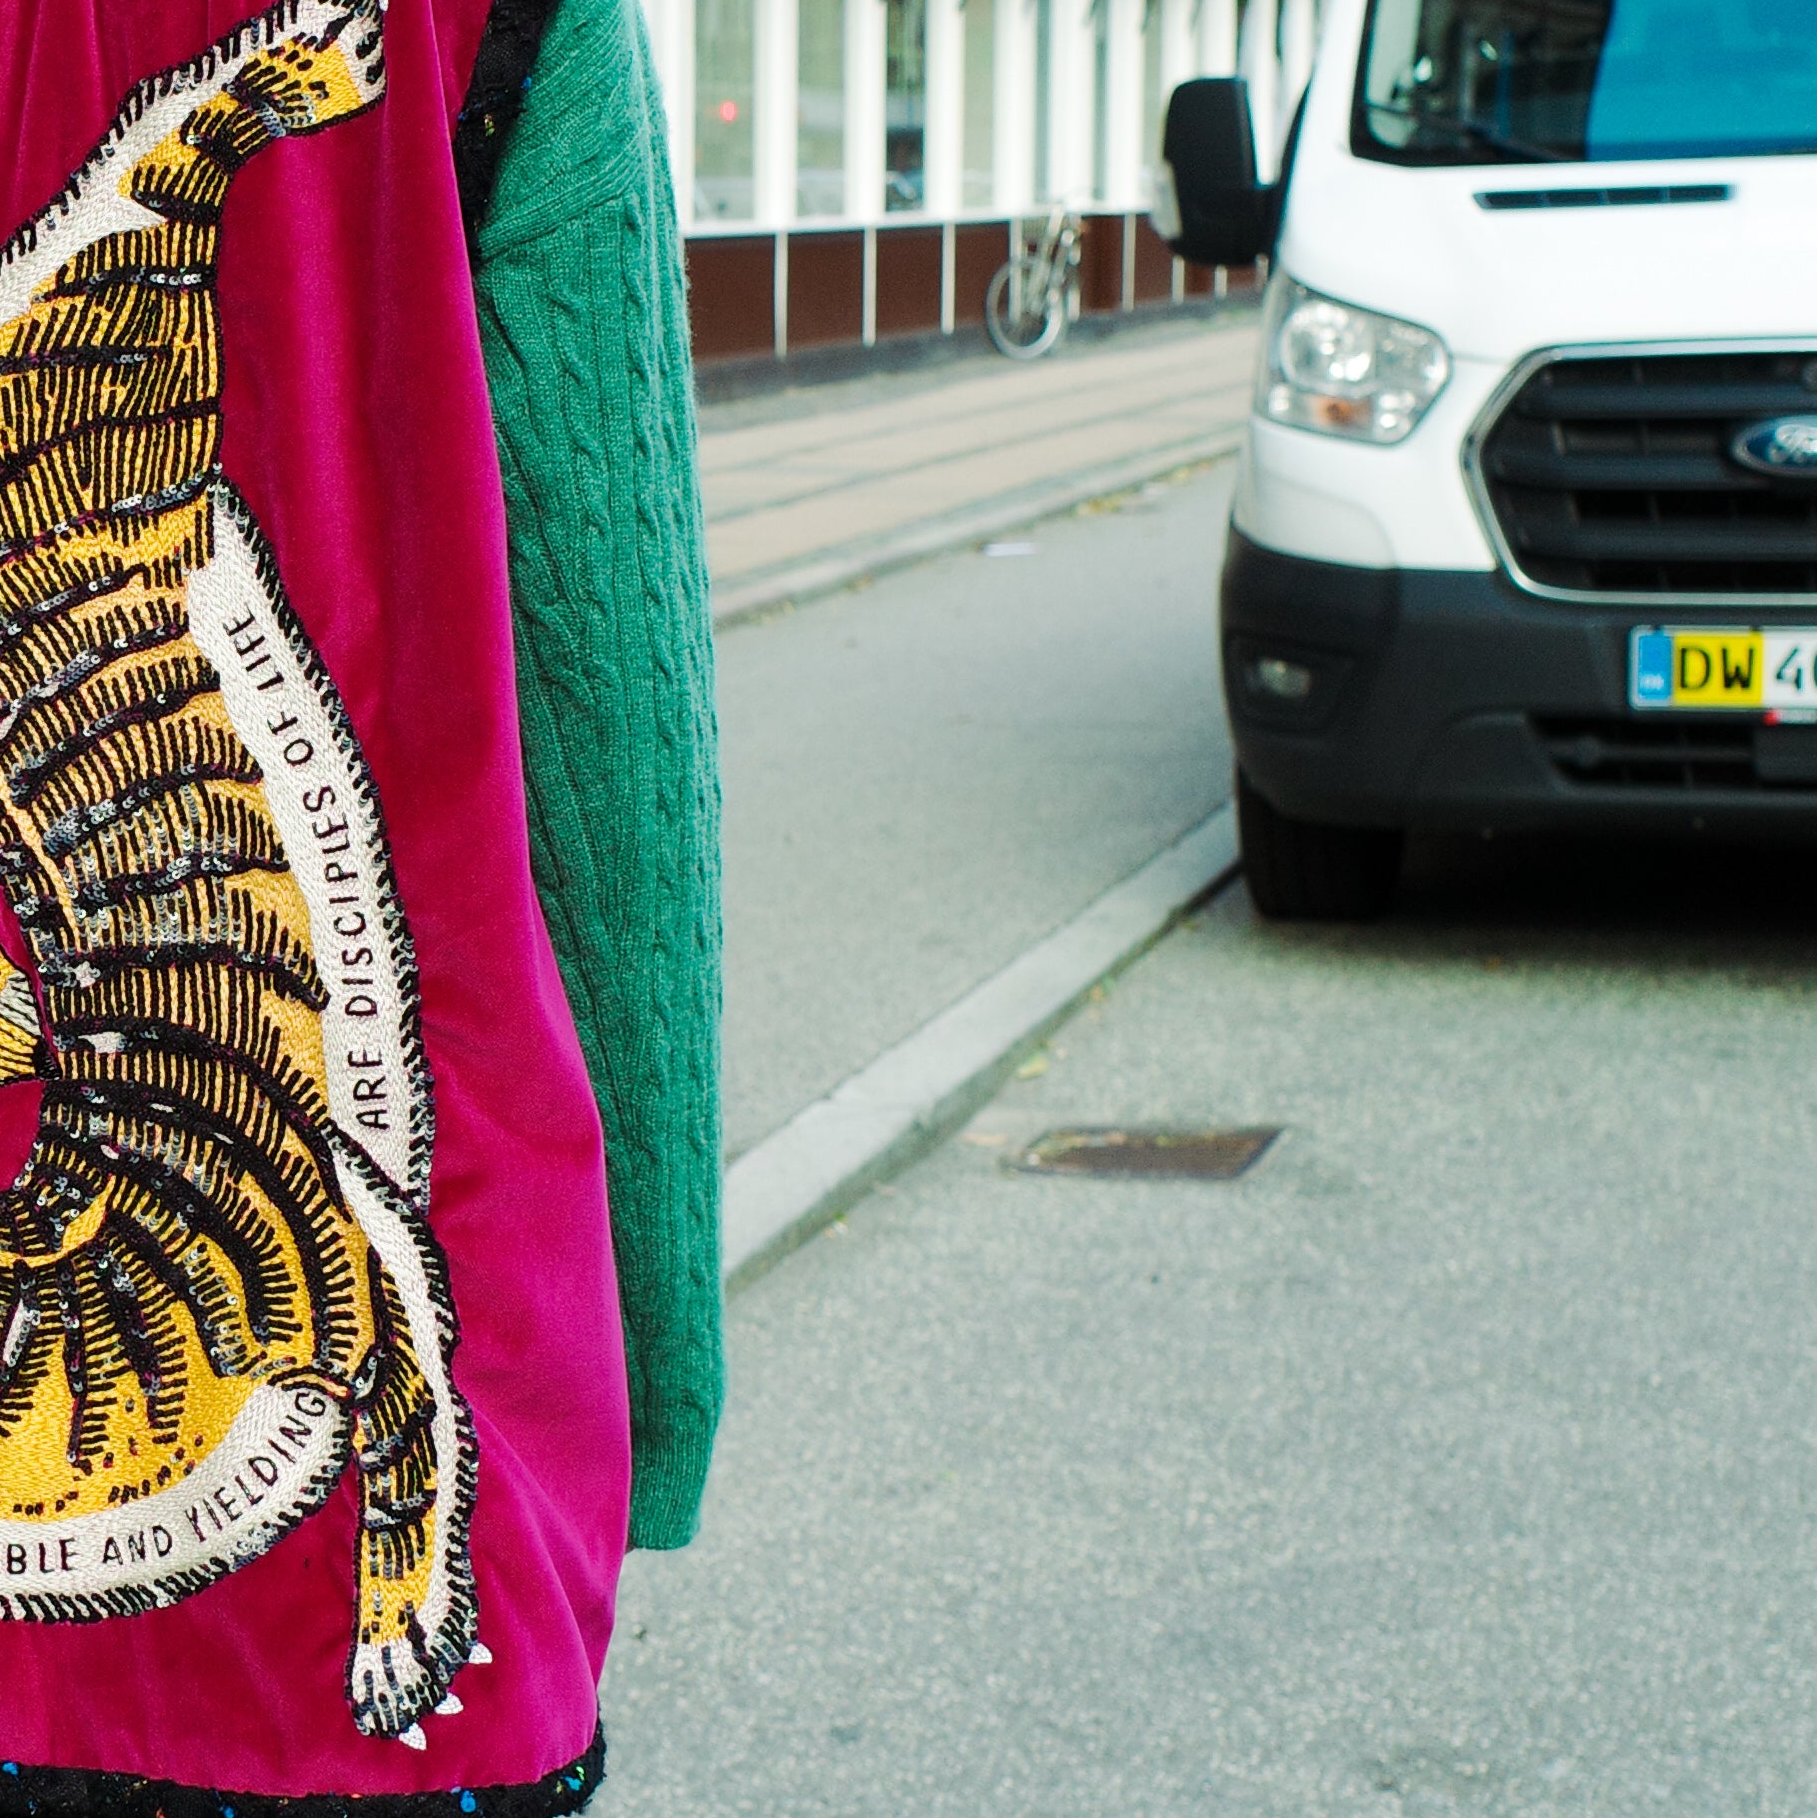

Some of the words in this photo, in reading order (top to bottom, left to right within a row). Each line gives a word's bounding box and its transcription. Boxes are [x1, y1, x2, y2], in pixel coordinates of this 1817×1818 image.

[223, 603, 285, 691] LIFE
[1680, 647, 1754, 690] DW
[1776, 647, 1817, 691] 4
[267, 711, 314, 766] OF
[303, 784, 379, 1017] DISCIPLES
[347, 1047, 390, 1129] ARE
[102, 1524, 173, 1566] AND
[184, 1391, 327, 1543] YIELDING
